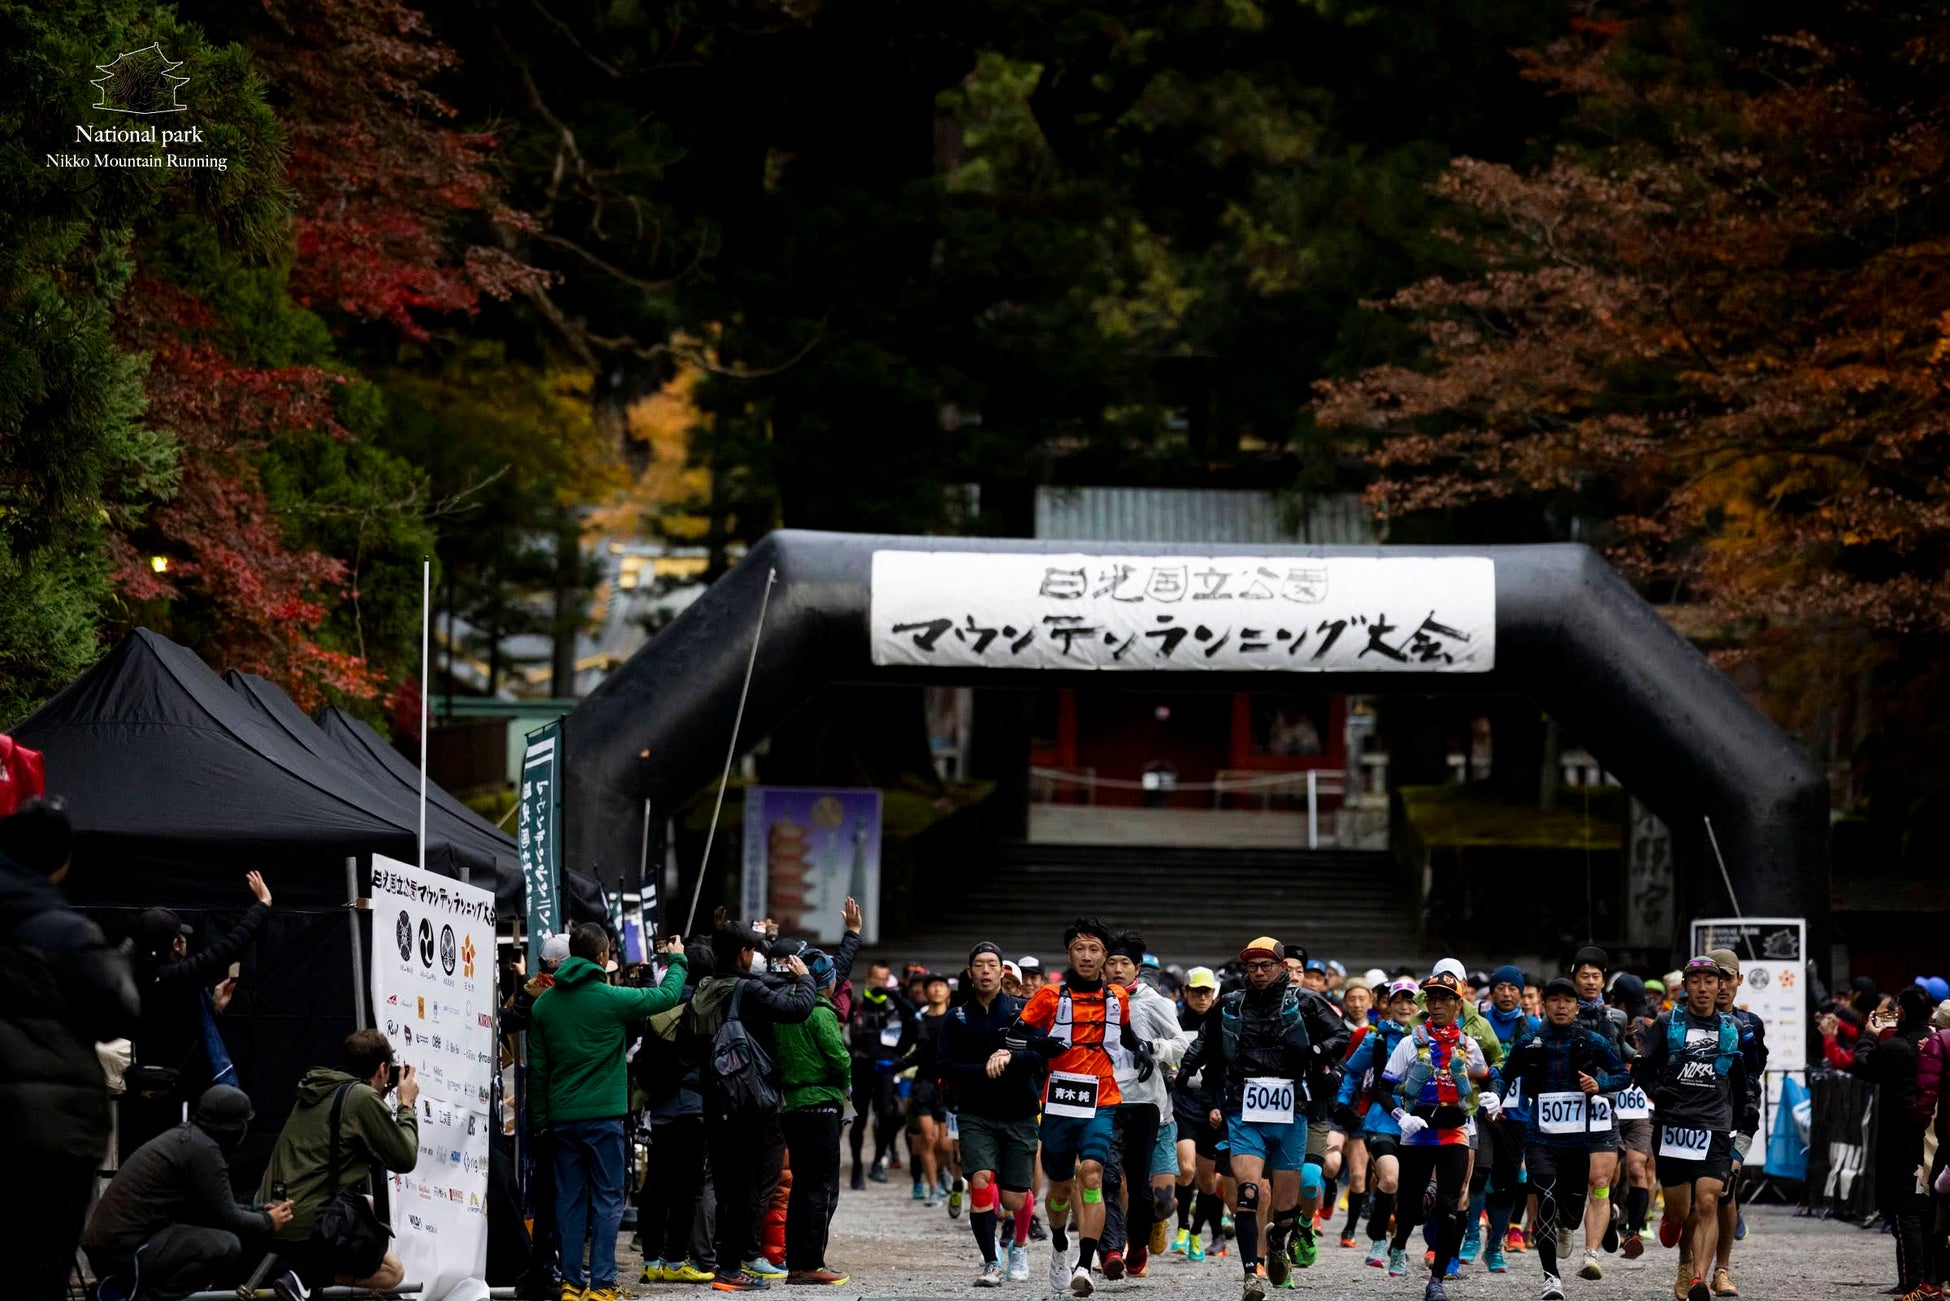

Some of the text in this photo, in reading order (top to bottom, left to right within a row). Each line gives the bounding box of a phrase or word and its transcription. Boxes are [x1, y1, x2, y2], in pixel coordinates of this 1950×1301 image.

[1039, 564, 1329, 604] 日光国立公園
[892, 609, 1472, 665] マウンテンランニング大会
[1055, 1087, 1090, 1103] 青木 純
[1246, 1087, 1292, 1111] 5040
[1542, 1100, 1583, 1122] 5077
[1664, 1126, 1707, 1150] 5002
